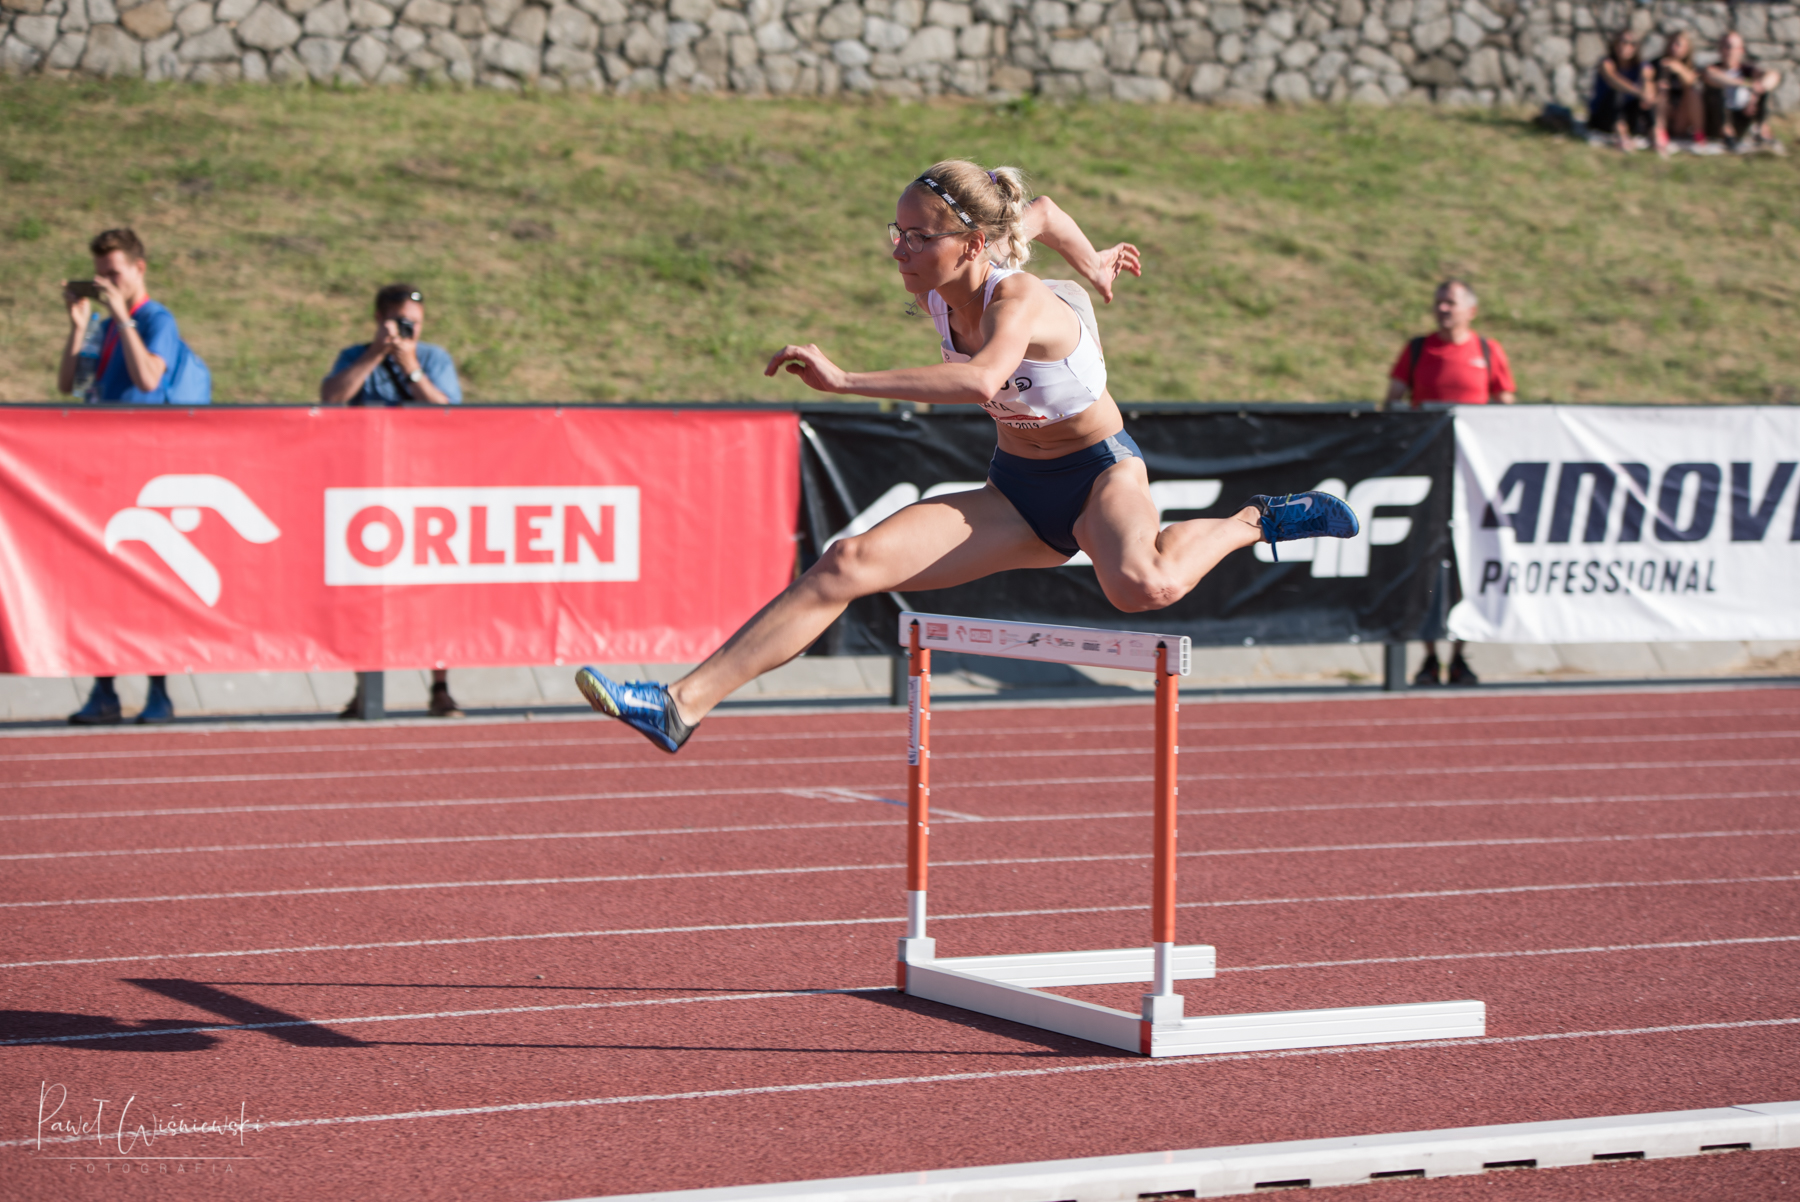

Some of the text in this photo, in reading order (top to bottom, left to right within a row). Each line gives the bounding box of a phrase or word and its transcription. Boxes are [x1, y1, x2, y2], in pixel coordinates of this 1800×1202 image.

[1482, 461, 1800, 543] AMOV
[346, 504, 616, 569] ORLEN
[1480, 560, 1718, 596] PROFESSIONAL
